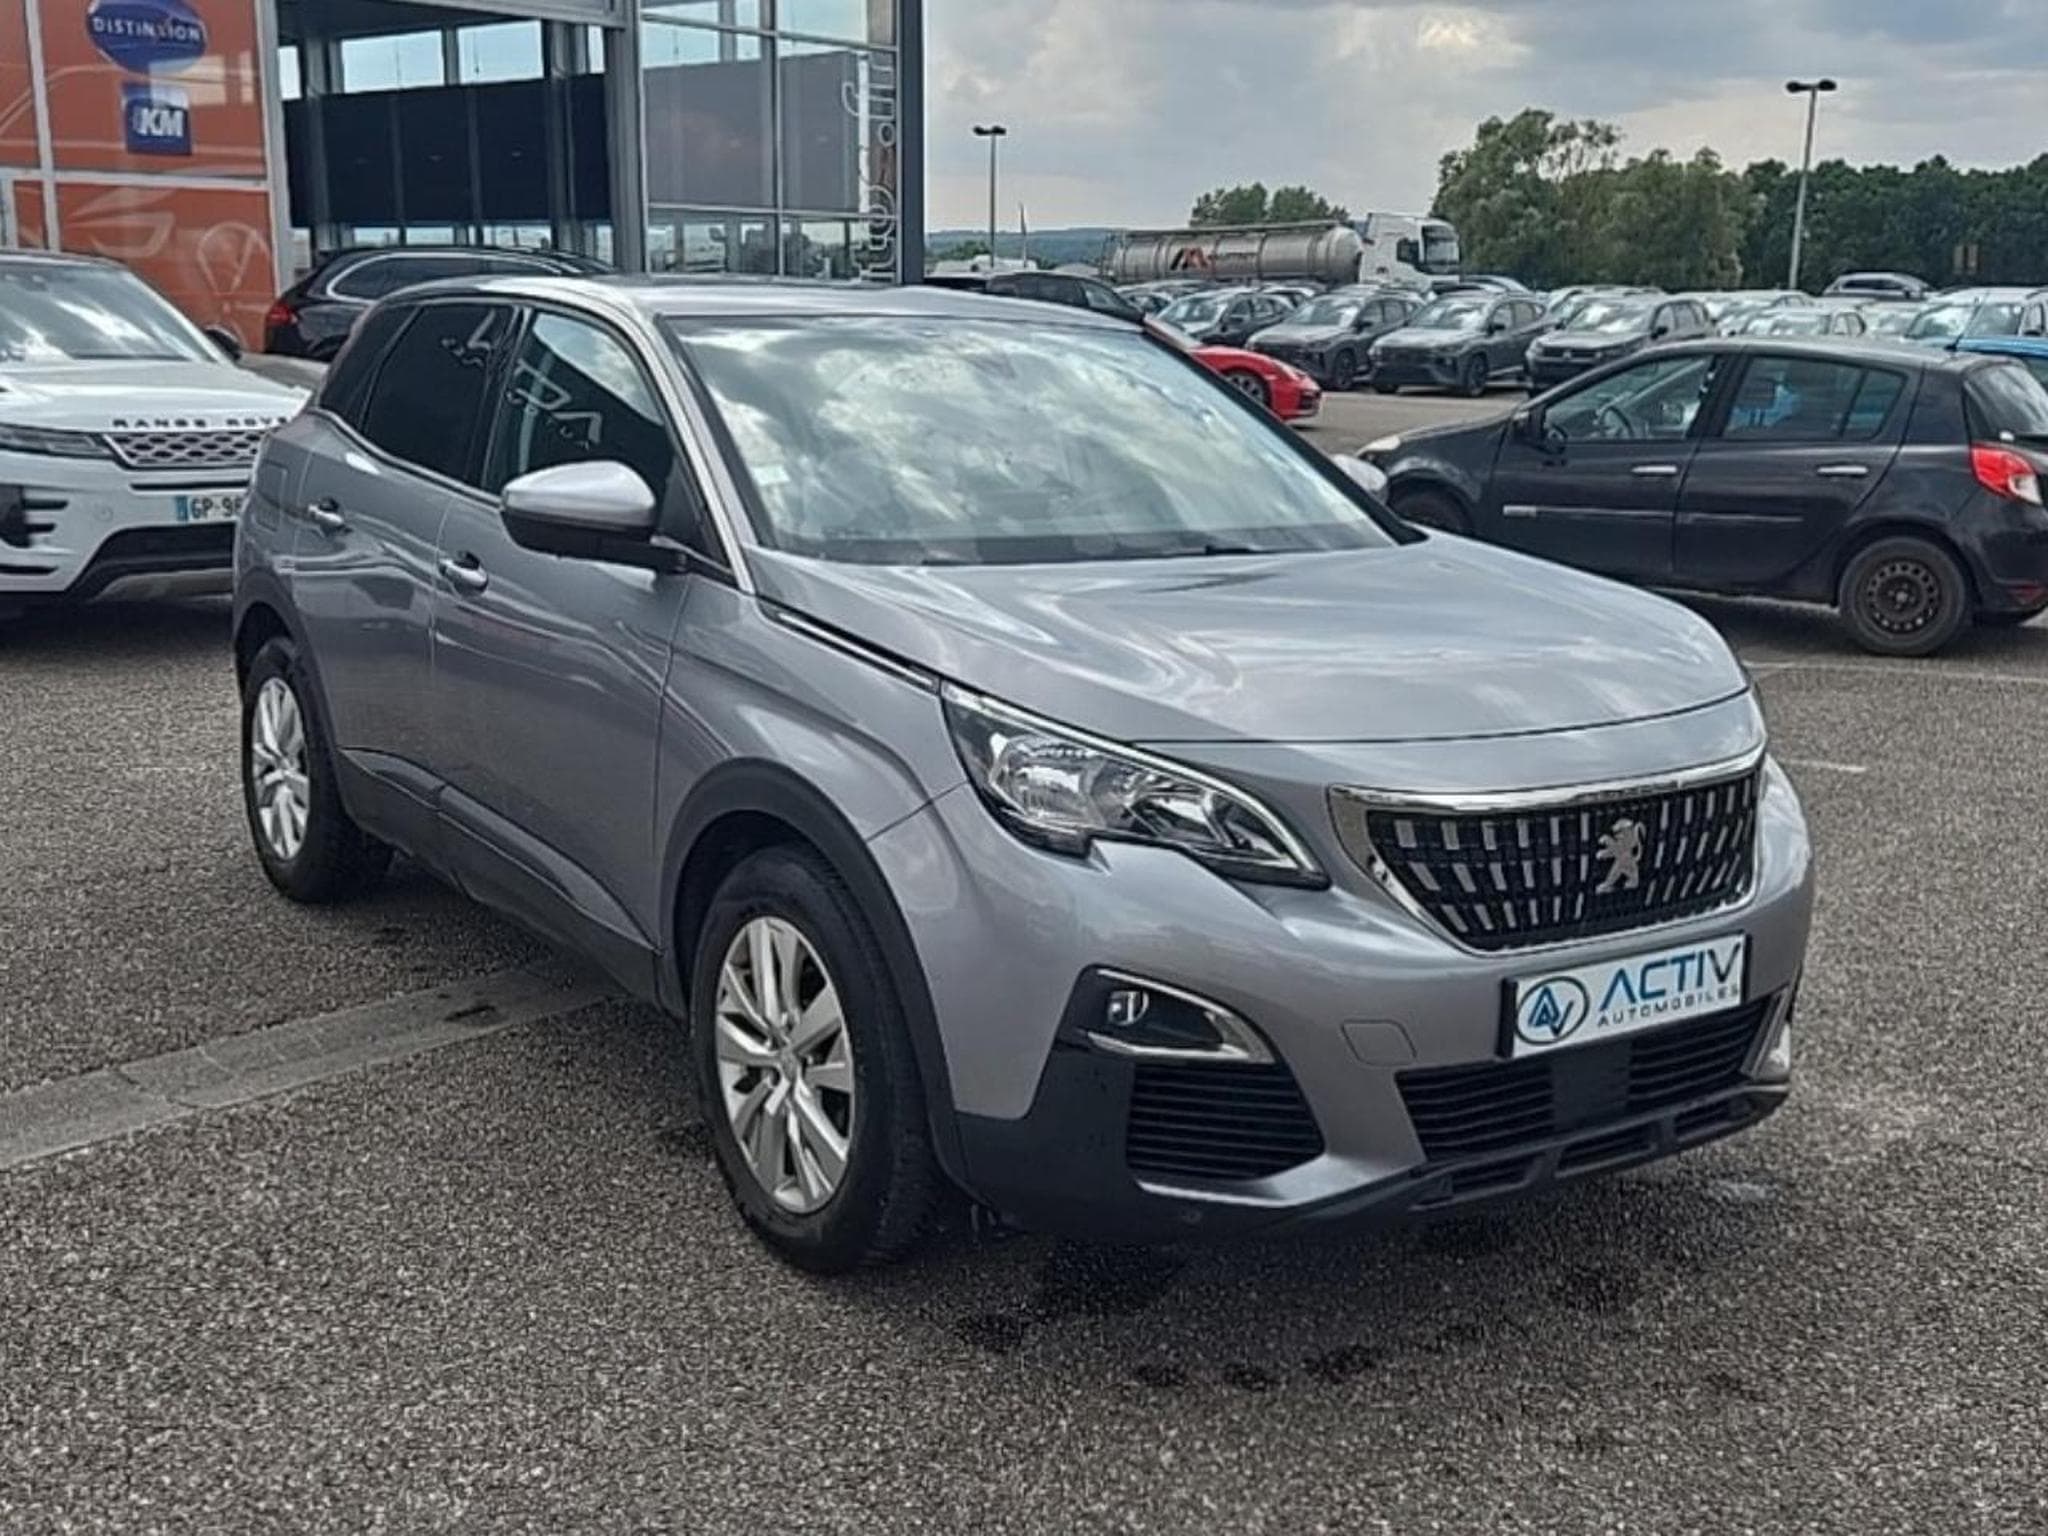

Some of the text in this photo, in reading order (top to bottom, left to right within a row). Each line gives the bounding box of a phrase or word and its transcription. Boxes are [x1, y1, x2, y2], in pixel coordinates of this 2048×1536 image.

[112, 417, 206, 428] RANGE
[1599, 942, 1740, 1012] ACTIV
[1598, 983, 1738, 1027] AUTOMOBILES
